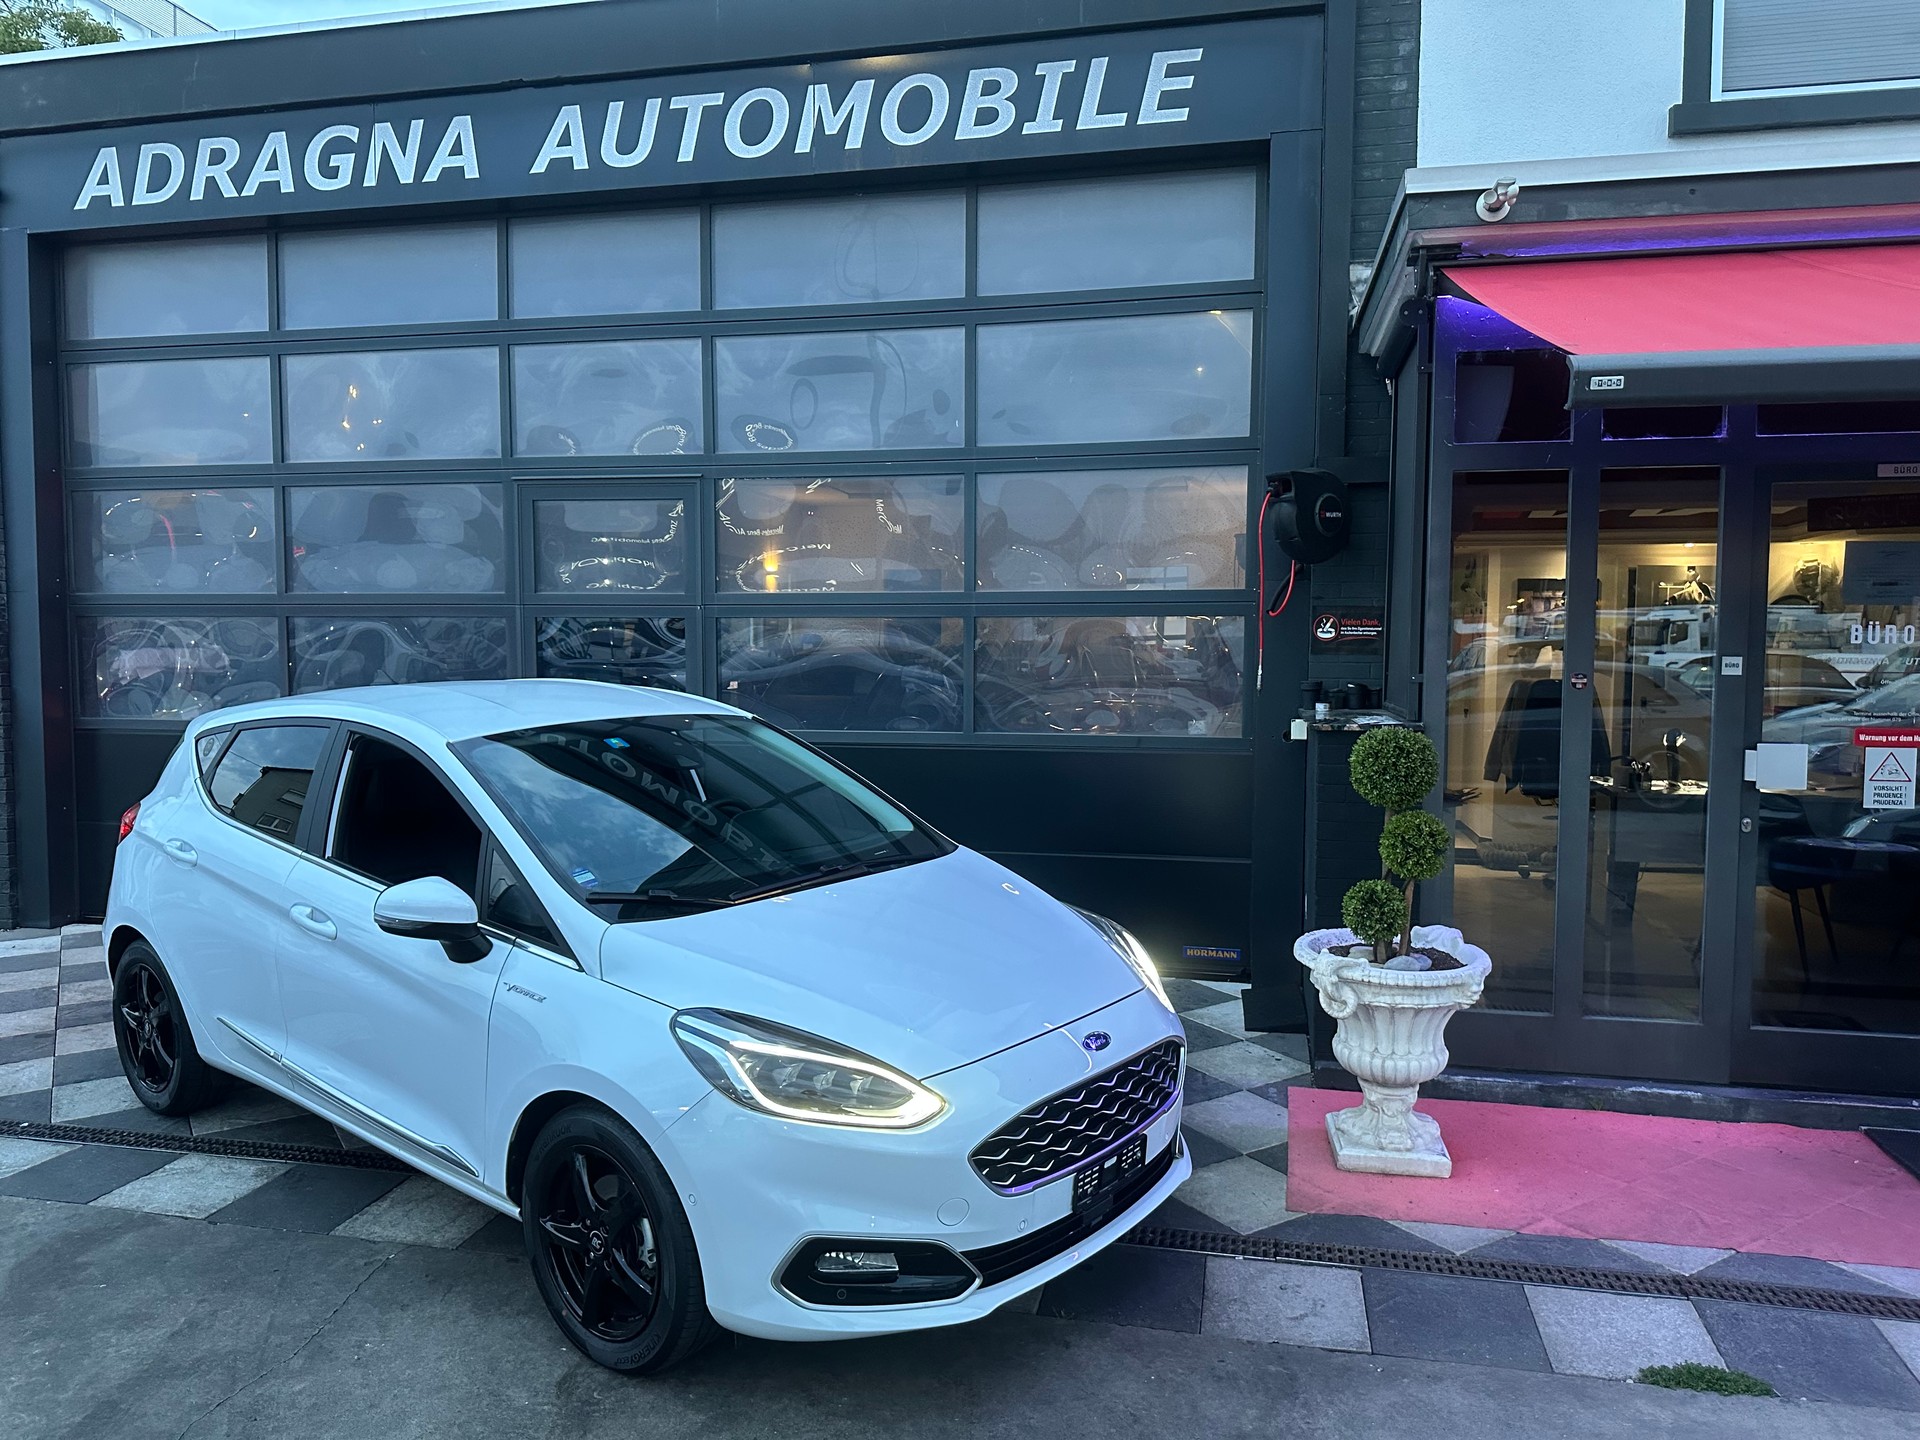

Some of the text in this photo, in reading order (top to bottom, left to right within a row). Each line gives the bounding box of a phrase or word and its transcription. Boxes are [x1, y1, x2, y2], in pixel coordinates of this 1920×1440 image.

[74, 47, 1204, 210] ADRAGNA AUTOMOBILE
[1893, 465, 1918, 474] BÜRO
[1341, 618, 1361, 626] Vielen
[1850, 620, 1915, 645] BÜRO
[1859, 734, 1887, 742] Warnung
